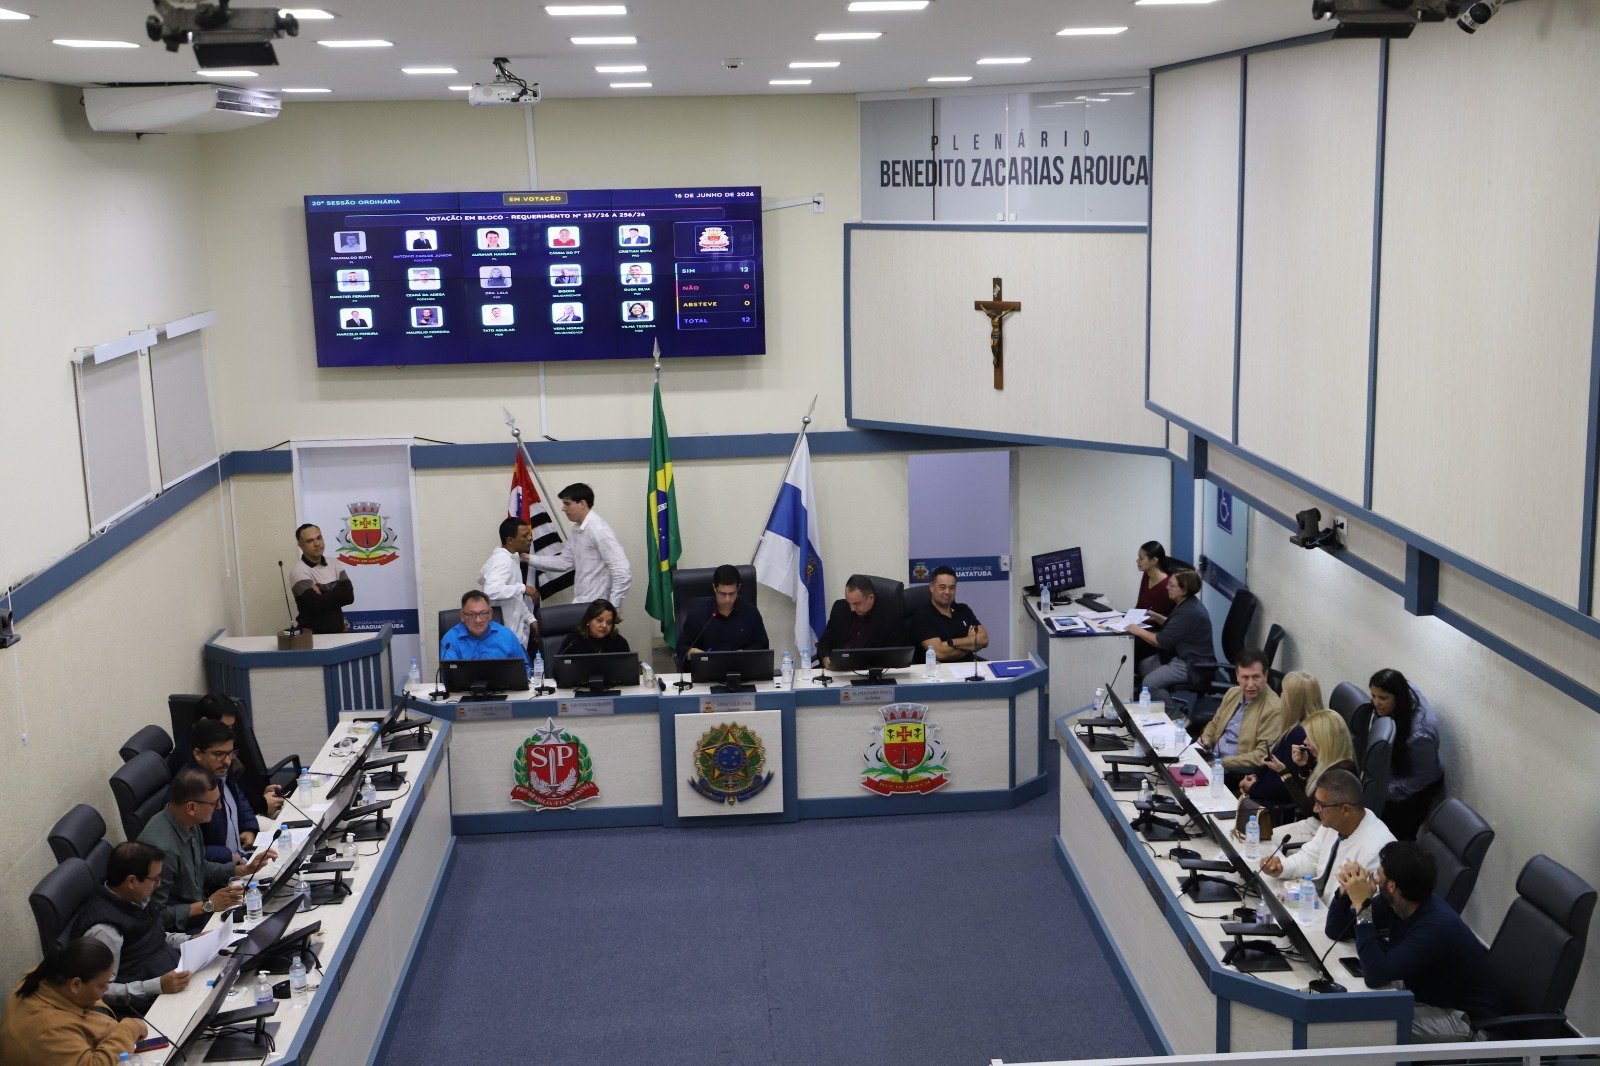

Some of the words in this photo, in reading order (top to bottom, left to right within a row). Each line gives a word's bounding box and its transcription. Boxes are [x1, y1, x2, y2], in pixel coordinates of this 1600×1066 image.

[930, 129, 1090, 151] PLENÁRIO
[880, 158, 966, 187] BENEDITO
[971, 155, 1064, 187] ZACARIAS
[1069, 155, 1149, 186] AROUCA
[523, 195, 562, 203] VOTAÇÃO
